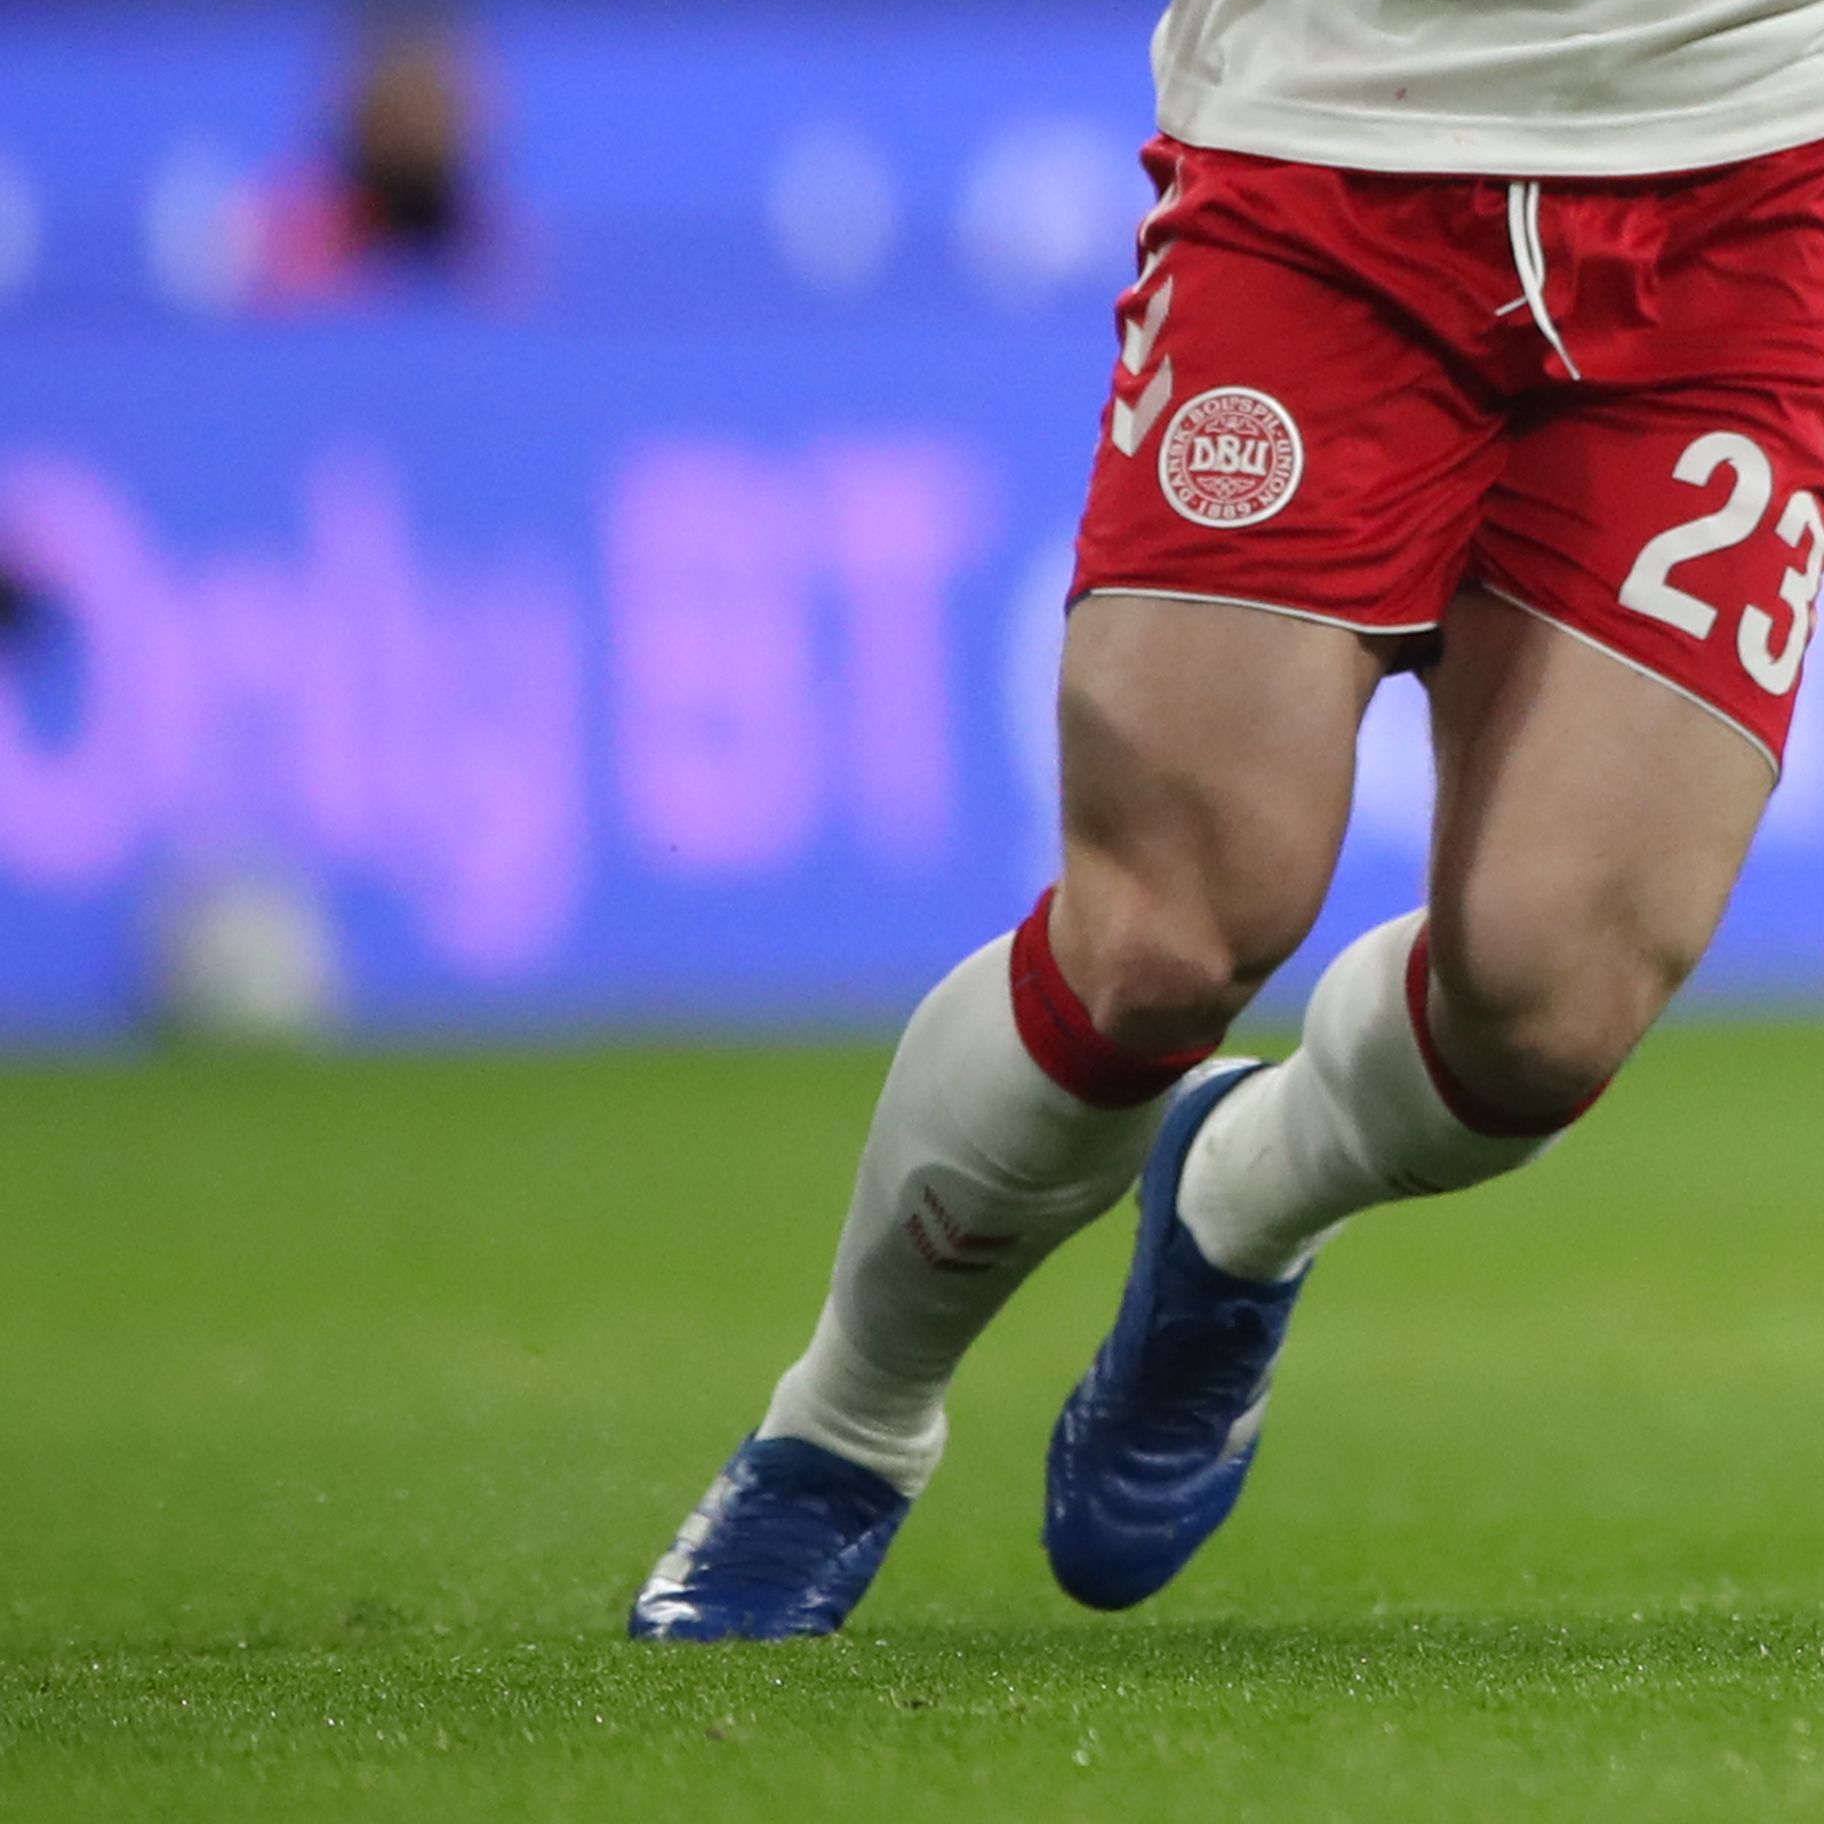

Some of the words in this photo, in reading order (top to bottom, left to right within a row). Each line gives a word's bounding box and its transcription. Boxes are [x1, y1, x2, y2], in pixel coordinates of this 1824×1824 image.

[1189, 434, 1269, 475] DBU
[1258, 439, 1292, 507] UNION
[610, 441, 990, 871] BT
